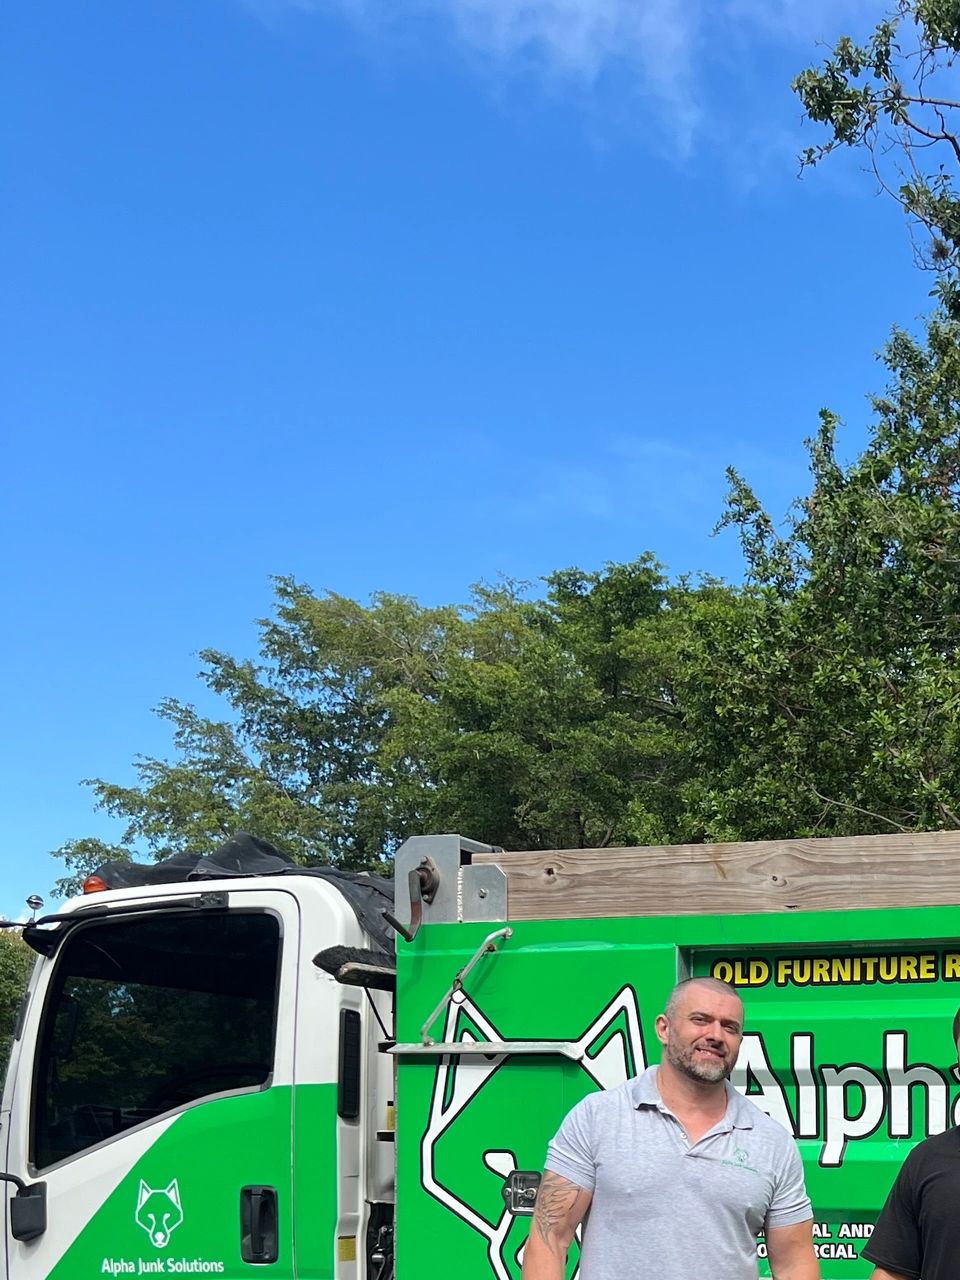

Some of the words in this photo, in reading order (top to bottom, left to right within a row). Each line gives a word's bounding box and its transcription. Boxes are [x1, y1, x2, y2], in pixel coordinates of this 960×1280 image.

[713, 960, 769, 985] OLD
[777, 955, 936, 984] FURNITURE
[839, 1223, 875, 1238] AND
[101, 1258, 136, 1277] Alpha
[138, 1257, 165, 1275] Junk
[167, 1257, 224, 1273] Solutions
